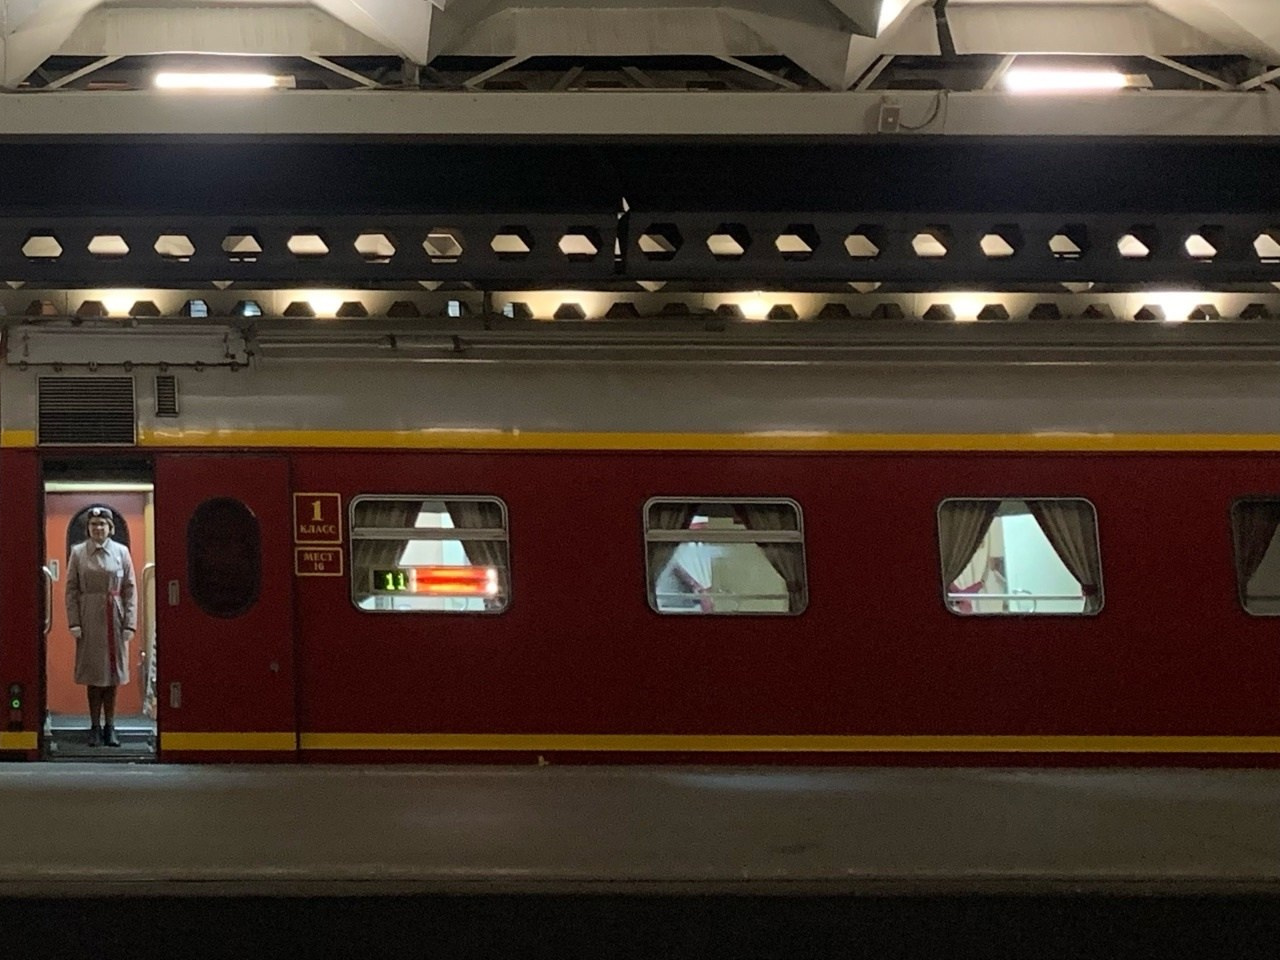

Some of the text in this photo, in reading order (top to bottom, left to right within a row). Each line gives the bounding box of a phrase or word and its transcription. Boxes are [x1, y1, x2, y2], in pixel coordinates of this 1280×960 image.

[311, 501, 323, 521] 1
[300, 525, 336, 534] КЛАСС
[303, 552, 333, 561] МЕСТ
[385, 572, 406, 590] 11
